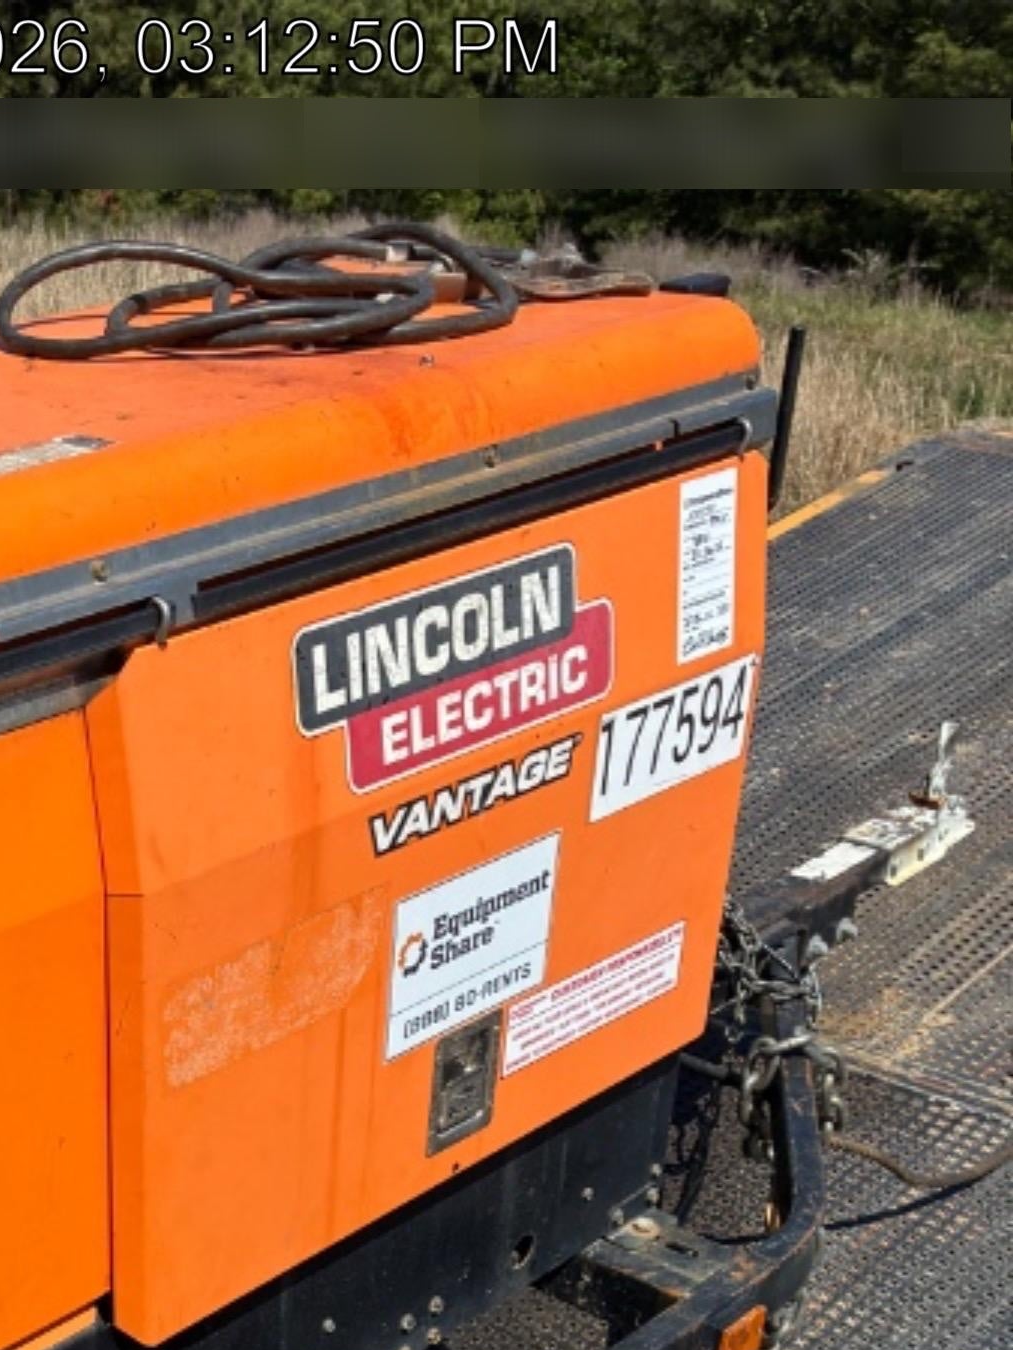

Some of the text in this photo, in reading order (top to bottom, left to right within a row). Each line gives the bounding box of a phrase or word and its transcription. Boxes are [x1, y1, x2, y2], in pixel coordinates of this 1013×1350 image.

[310, 564, 562, 715] LINCOLN
[380, 645, 589, 767] ELECTRIC
[599, 663, 748, 796] 177594
[370, 737, 574, 856] VANTAGE
[429, 923, 495, 971] Share
[432, 869, 550, 941] Equipment
